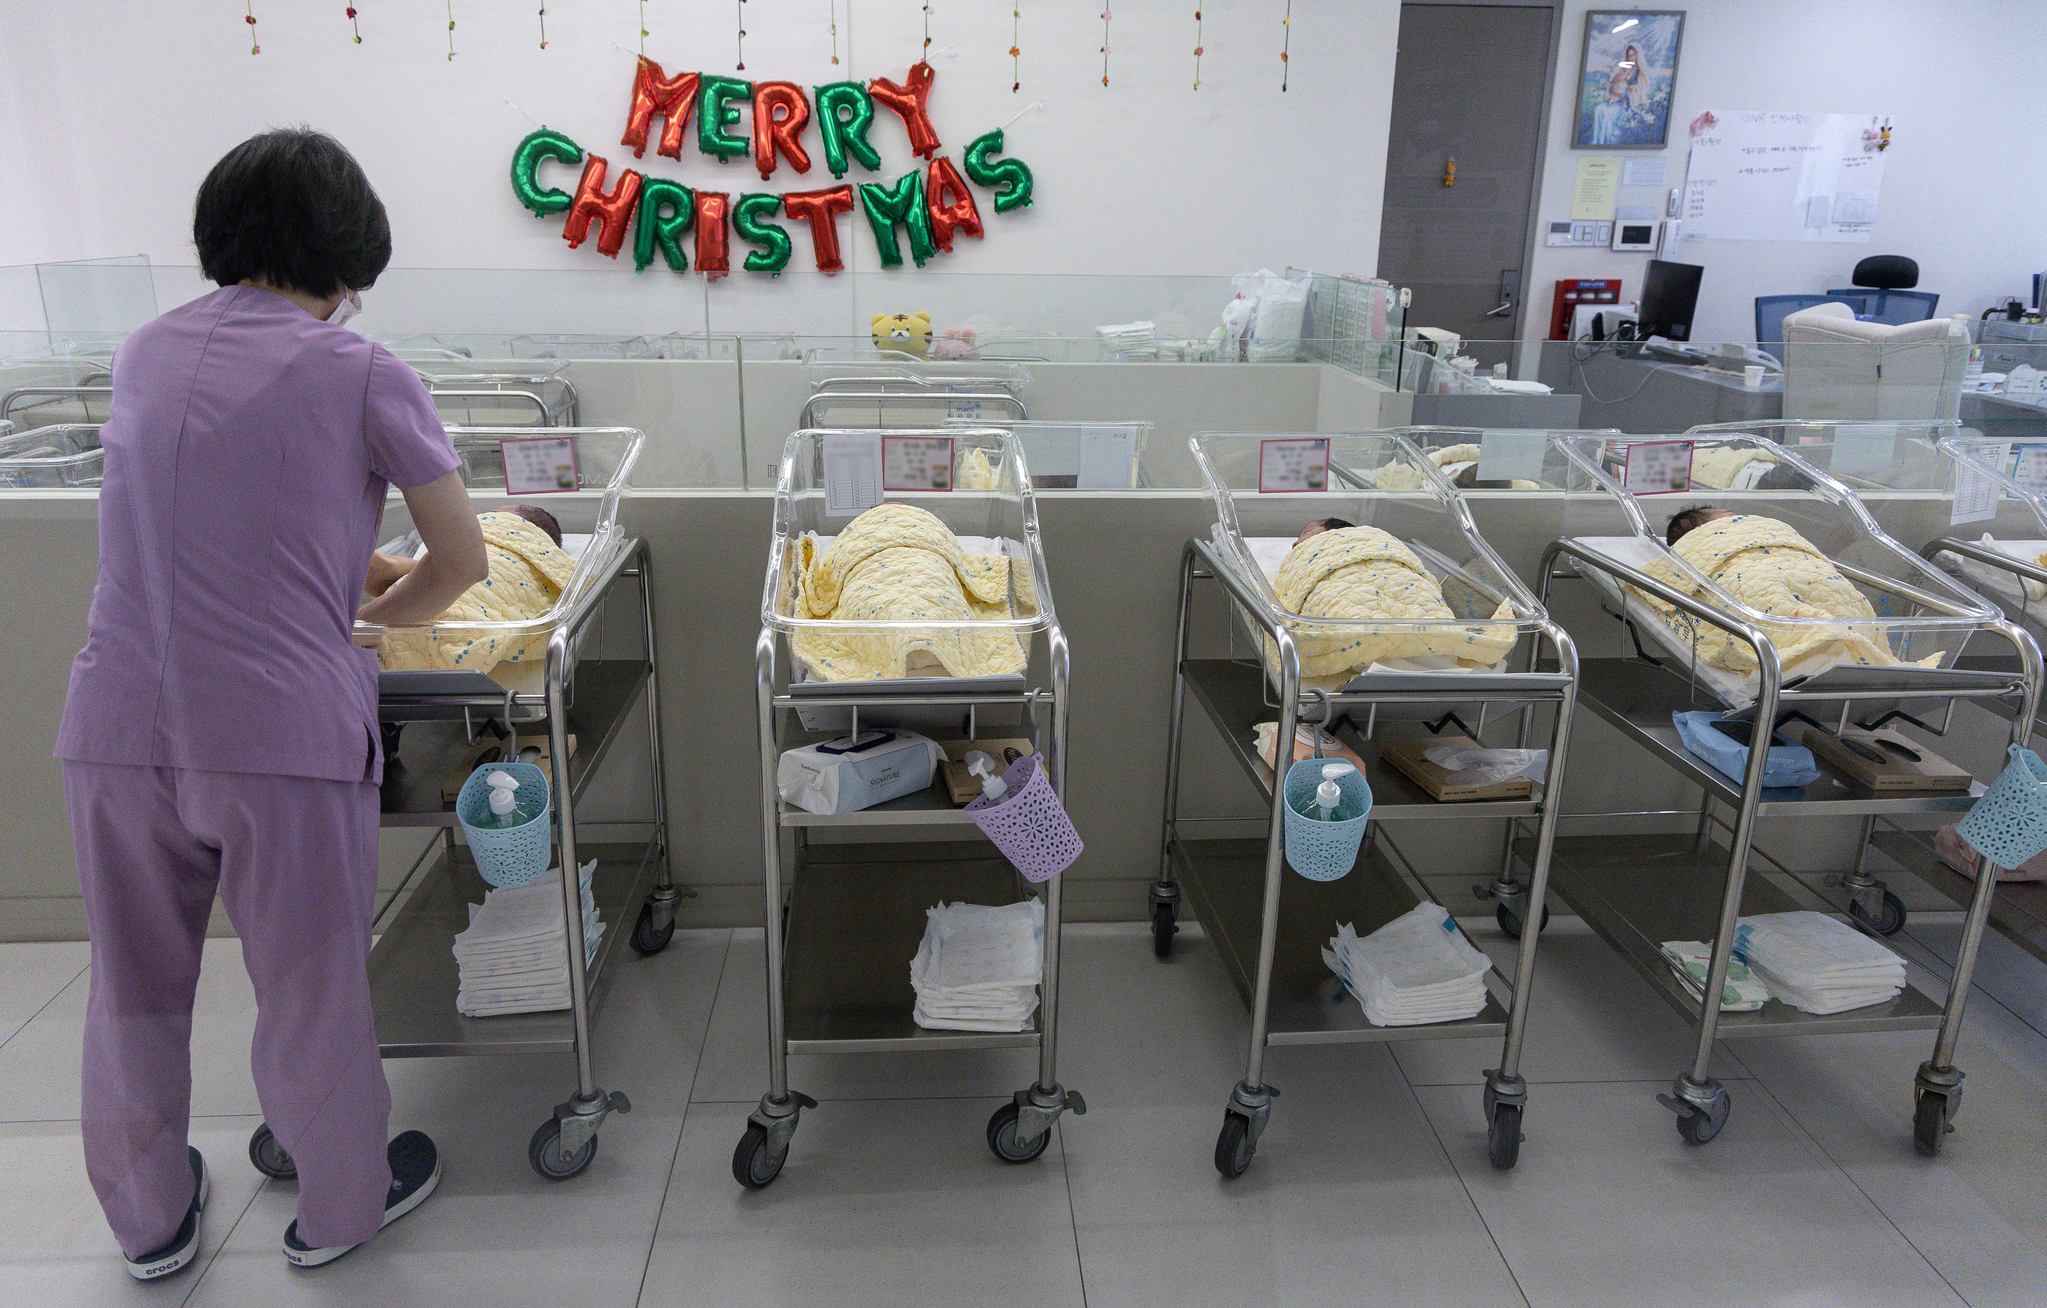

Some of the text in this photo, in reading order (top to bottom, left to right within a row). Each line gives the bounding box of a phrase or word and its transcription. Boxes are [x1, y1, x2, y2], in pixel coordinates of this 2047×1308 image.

[621, 55, 942, 180] MERRY
[510, 127, 1035, 278] CHRISTMAS
[145, 1259, 180, 1275] crocs
